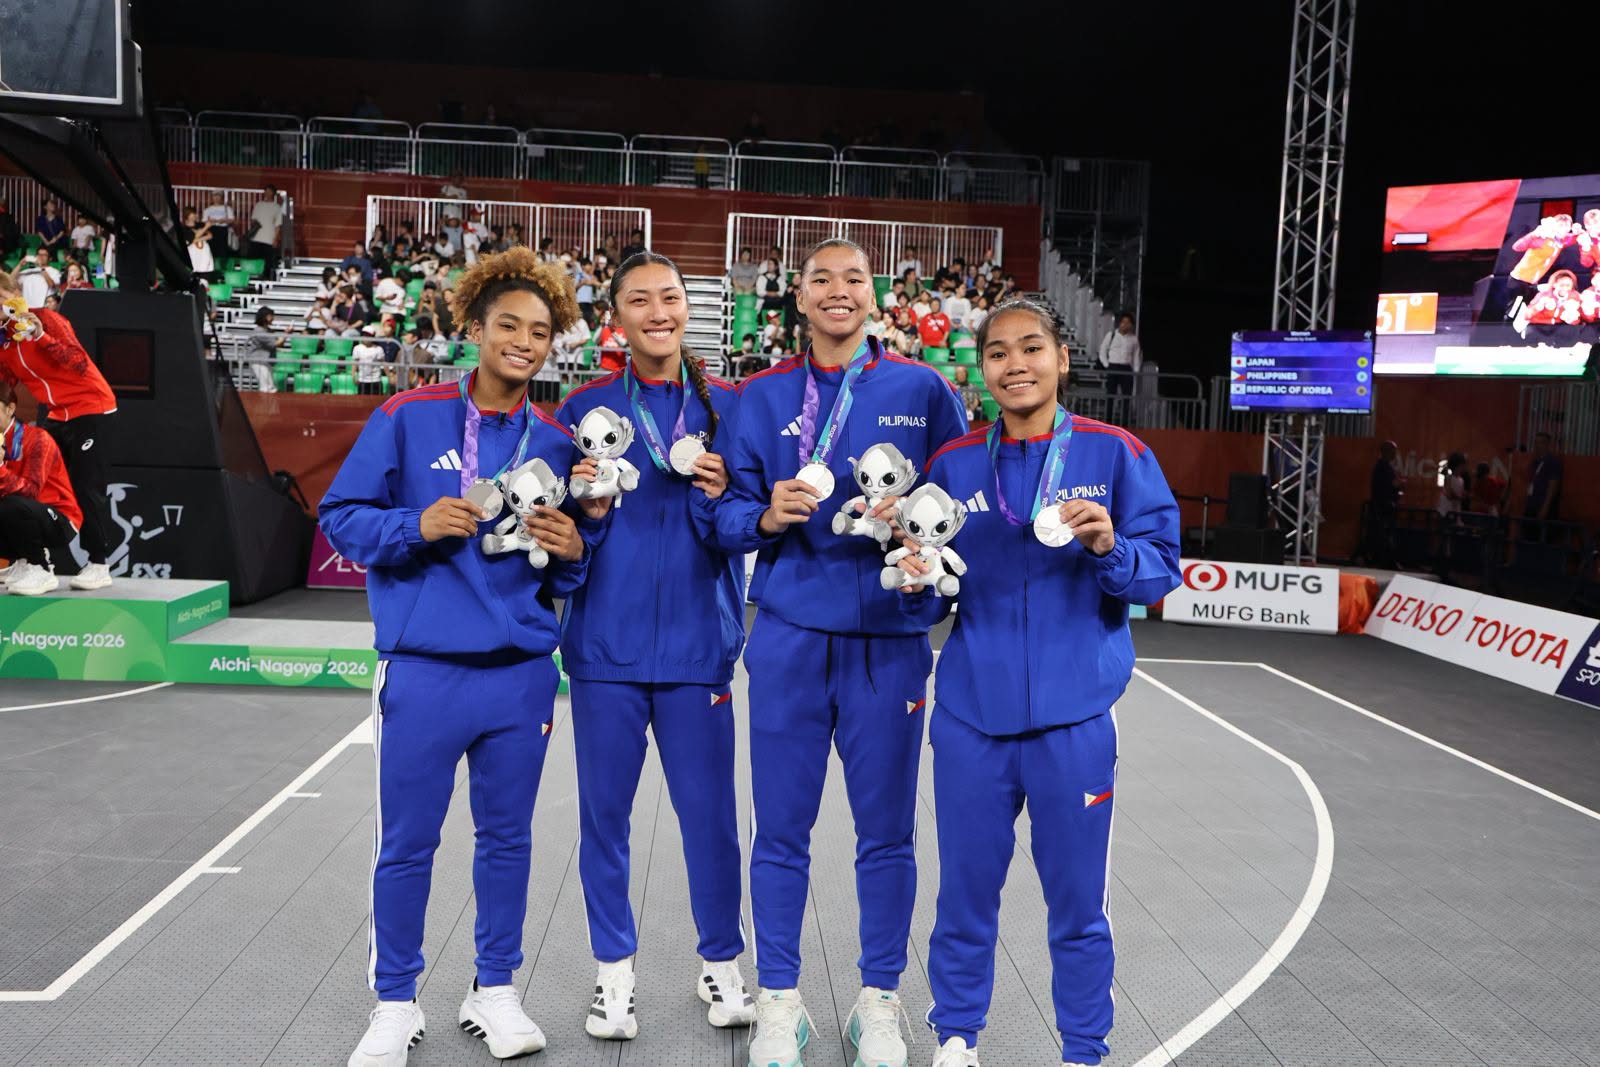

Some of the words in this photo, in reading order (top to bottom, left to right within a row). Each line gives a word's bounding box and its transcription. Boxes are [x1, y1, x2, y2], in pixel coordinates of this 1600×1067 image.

[1247, 358, 1276, 367] JAPAN
[1246, 371, 1298, 381] PHILIPPINES
[1246, 385, 1287, 394] REPUBLIC
[1288, 386, 1301, 394] OF
[1302, 386, 1333, 395] KOREA
[878, 415, 927, 428] PILIPINAS
[1056, 485, 1106, 500] PILIPINAS
[1235, 570, 1322, 594] MUFG
[1192, 603, 1253, 621] MUFG
[1260, 608, 1310, 626] Bank
[1376, 592, 1463, 636] DENSO
[1465, 615, 1569, 669] TOYOTA
[82, 633, 125, 648] 2026
[209, 657, 323, 678] Aichi-Nagoya
[327, 661, 368, 675] 2026
